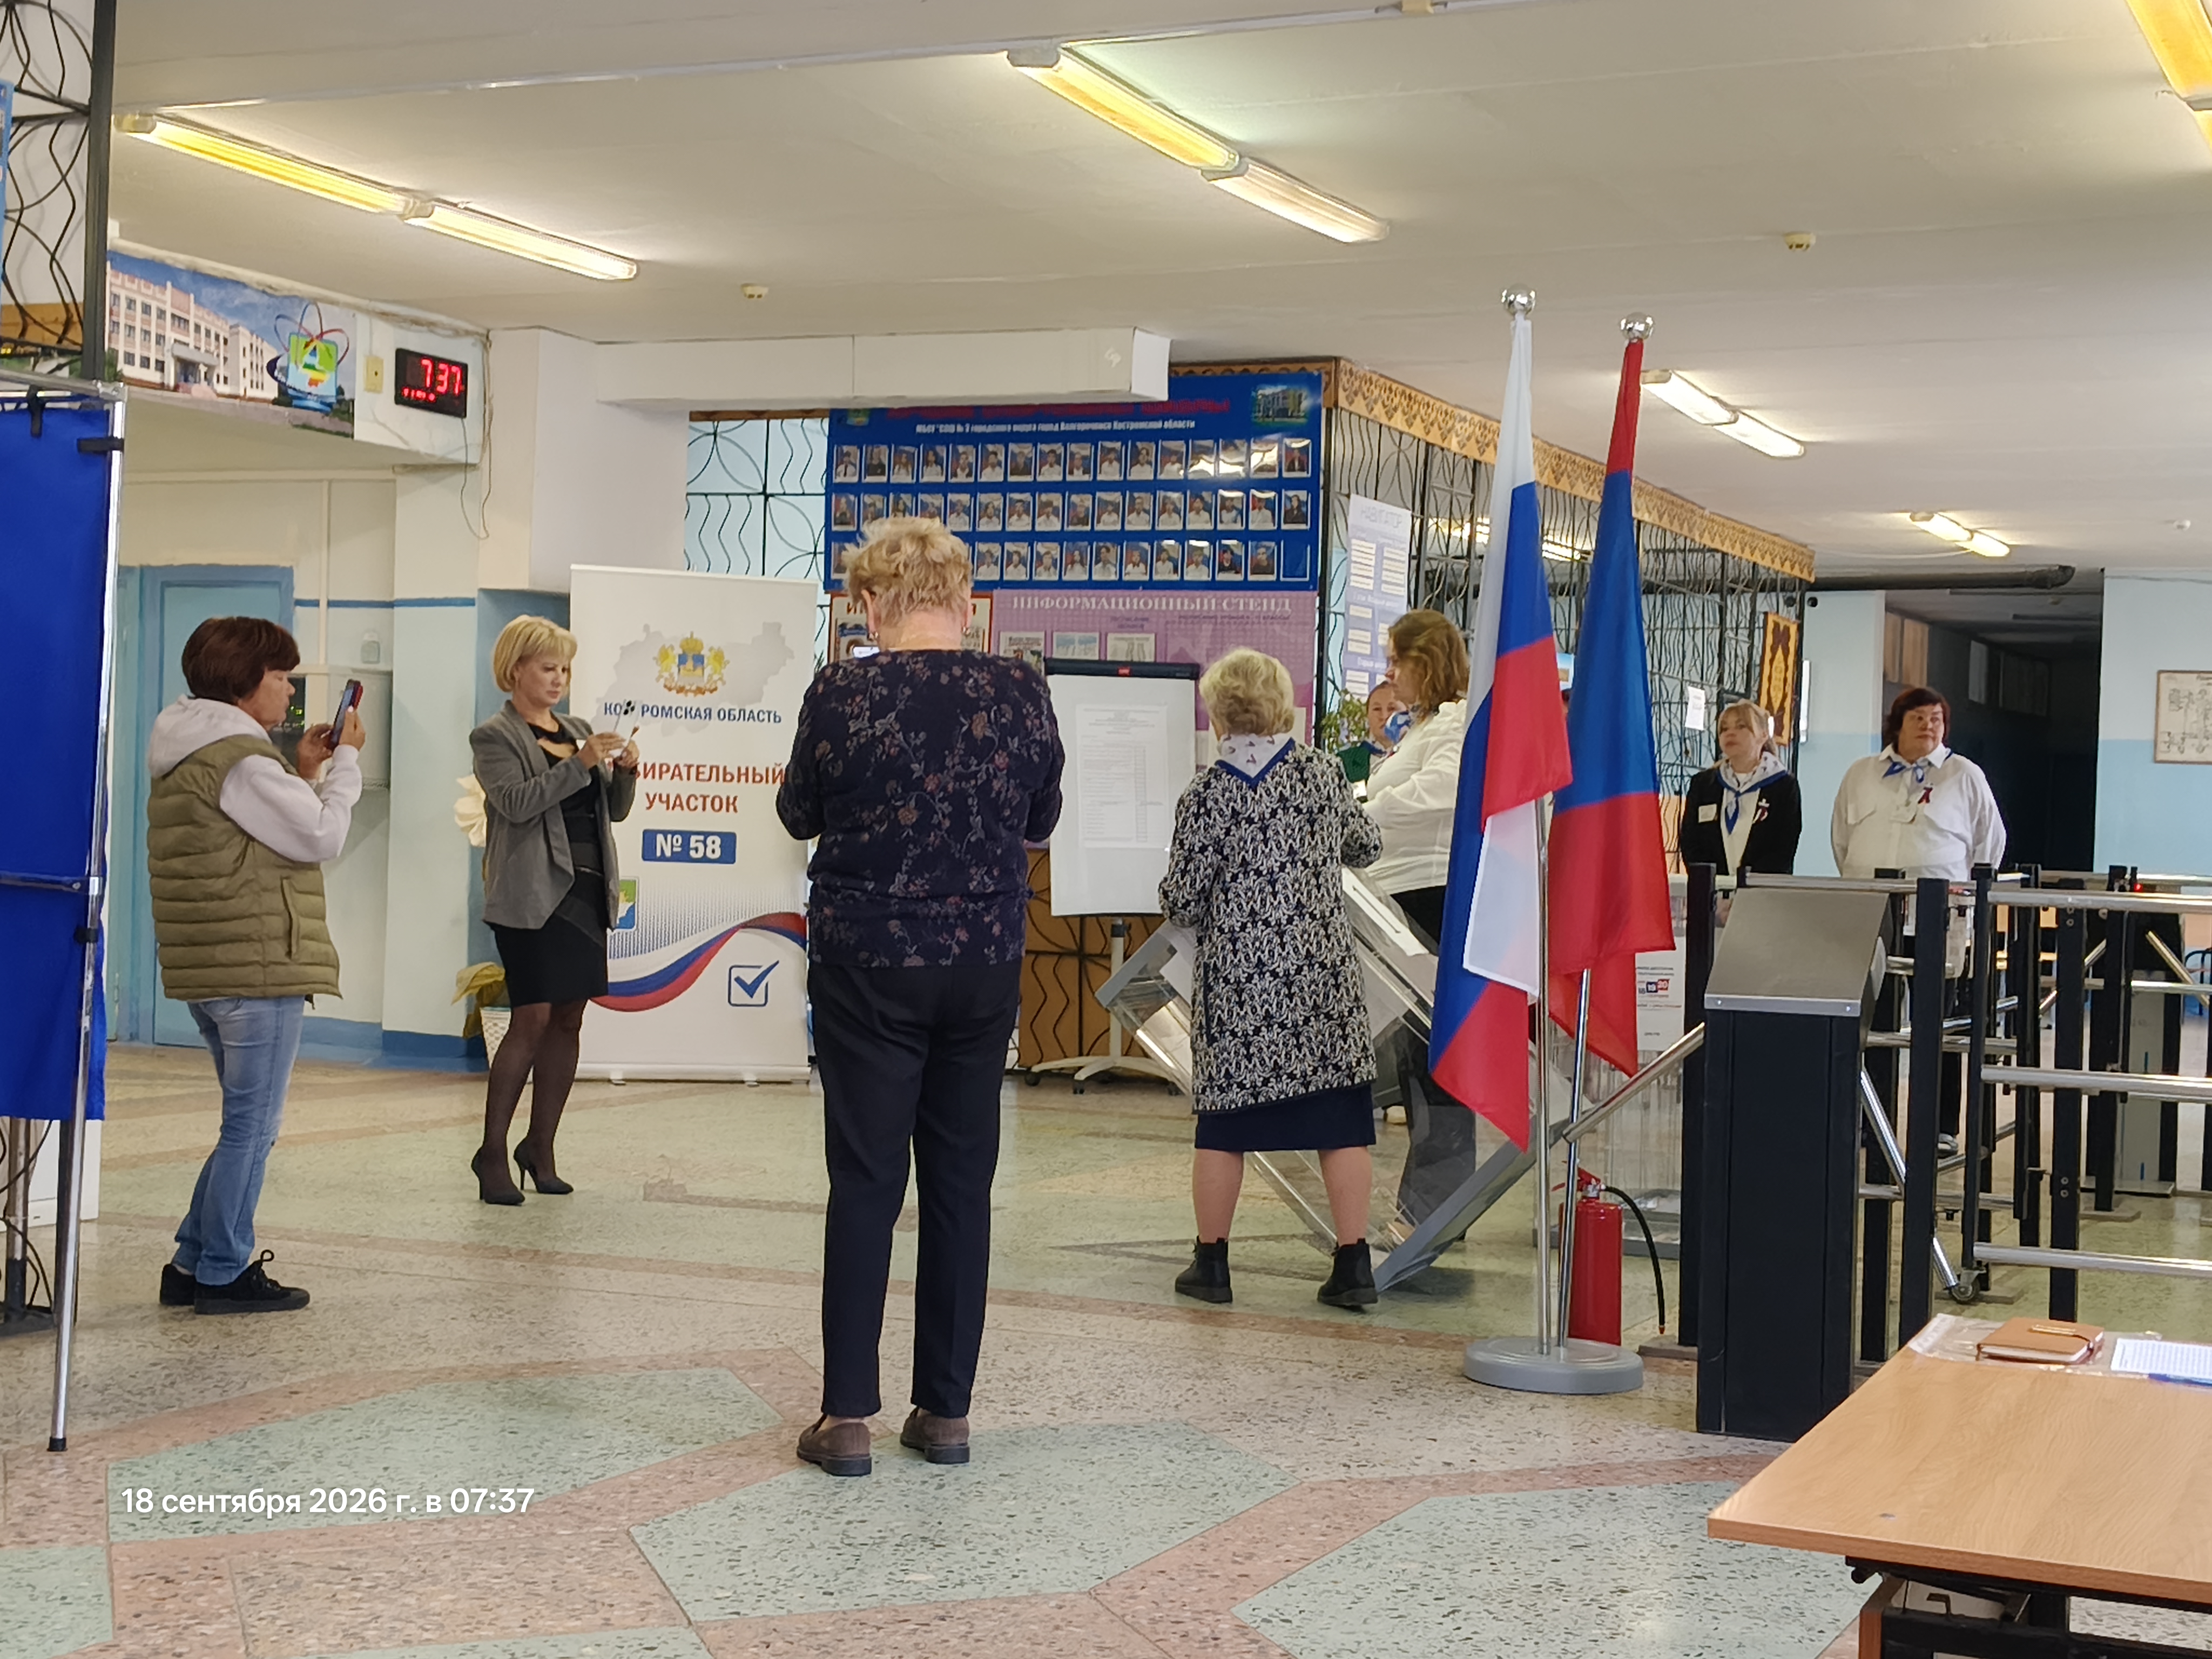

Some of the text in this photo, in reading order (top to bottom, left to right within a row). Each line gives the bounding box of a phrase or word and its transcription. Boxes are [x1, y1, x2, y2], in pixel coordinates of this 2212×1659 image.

[1013, 595, 1292, 615] ИНФОРМАЦИОННЫЙ СТЕНД
[604, 702, 781, 724] КОРОМСКАЯ ОБЛАСТЬ
[607, 761, 785, 785] ИРАТЕЛЬНЫЙ
[645, 792, 738, 813] УЧАСТОК
[656, 833, 721, 859] № 58
